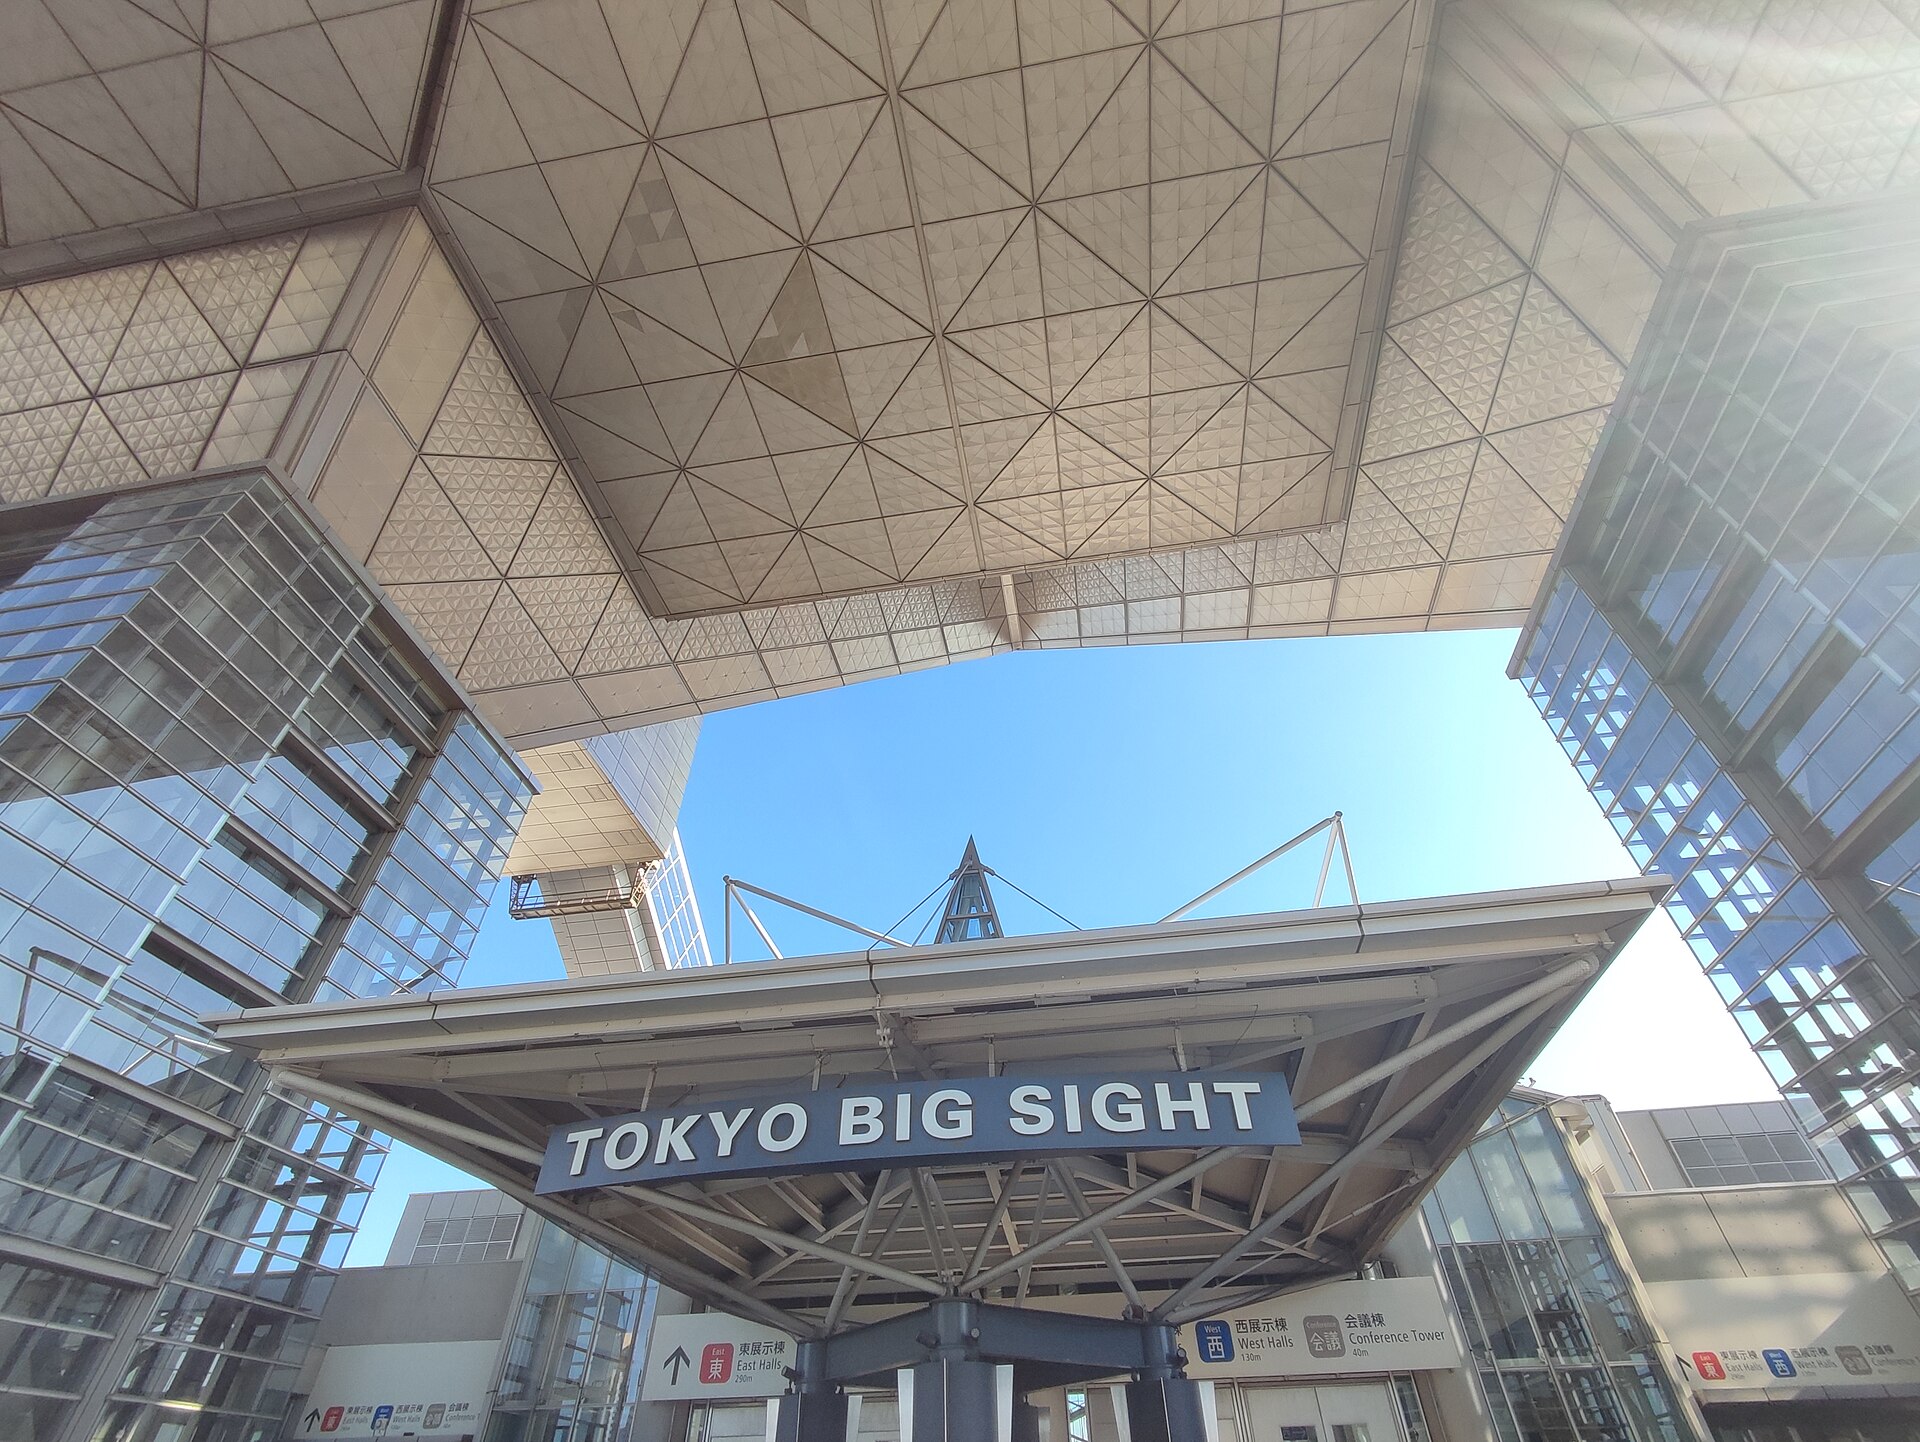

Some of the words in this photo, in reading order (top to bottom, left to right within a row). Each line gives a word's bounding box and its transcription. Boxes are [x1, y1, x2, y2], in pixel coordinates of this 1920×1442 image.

[566, 1103, 809, 1176] TOKYO
[838, 1088, 974, 1146] BIG
[1008, 1081, 1262, 1136] SIGHT
[1204, 1325, 1221, 1333] West
[1235, 1317, 1288, 1333] 西展示棟
[1345, 1313, 1386, 1329] 会議棟
[1238, 1338, 1265, 1349] West
[1268, 1335, 1294, 1348] Halls
[1310, 1331, 1342, 1351] 会議
[1349, 1332, 1409, 1345] Conference
[1411, 1329, 1445, 1342] Tower
[712, 1347, 725, 1356] East
[739, 1340, 786, 1356] 東展示棟
[1207, 1336, 1225, 1359] 西
[1352, 1348, 1369, 1357] 40m
[737, 1359, 756, 1371] East
[759, 1358, 782, 1370] Halls
[1241, 1353, 1262, 1362] 130m
[707, 1358, 724, 1380] 東
[1703, 1362, 1719, 1378] 東
[1725, 1363, 1743, 1372] East
[734, 1374, 753, 1383] 290m
